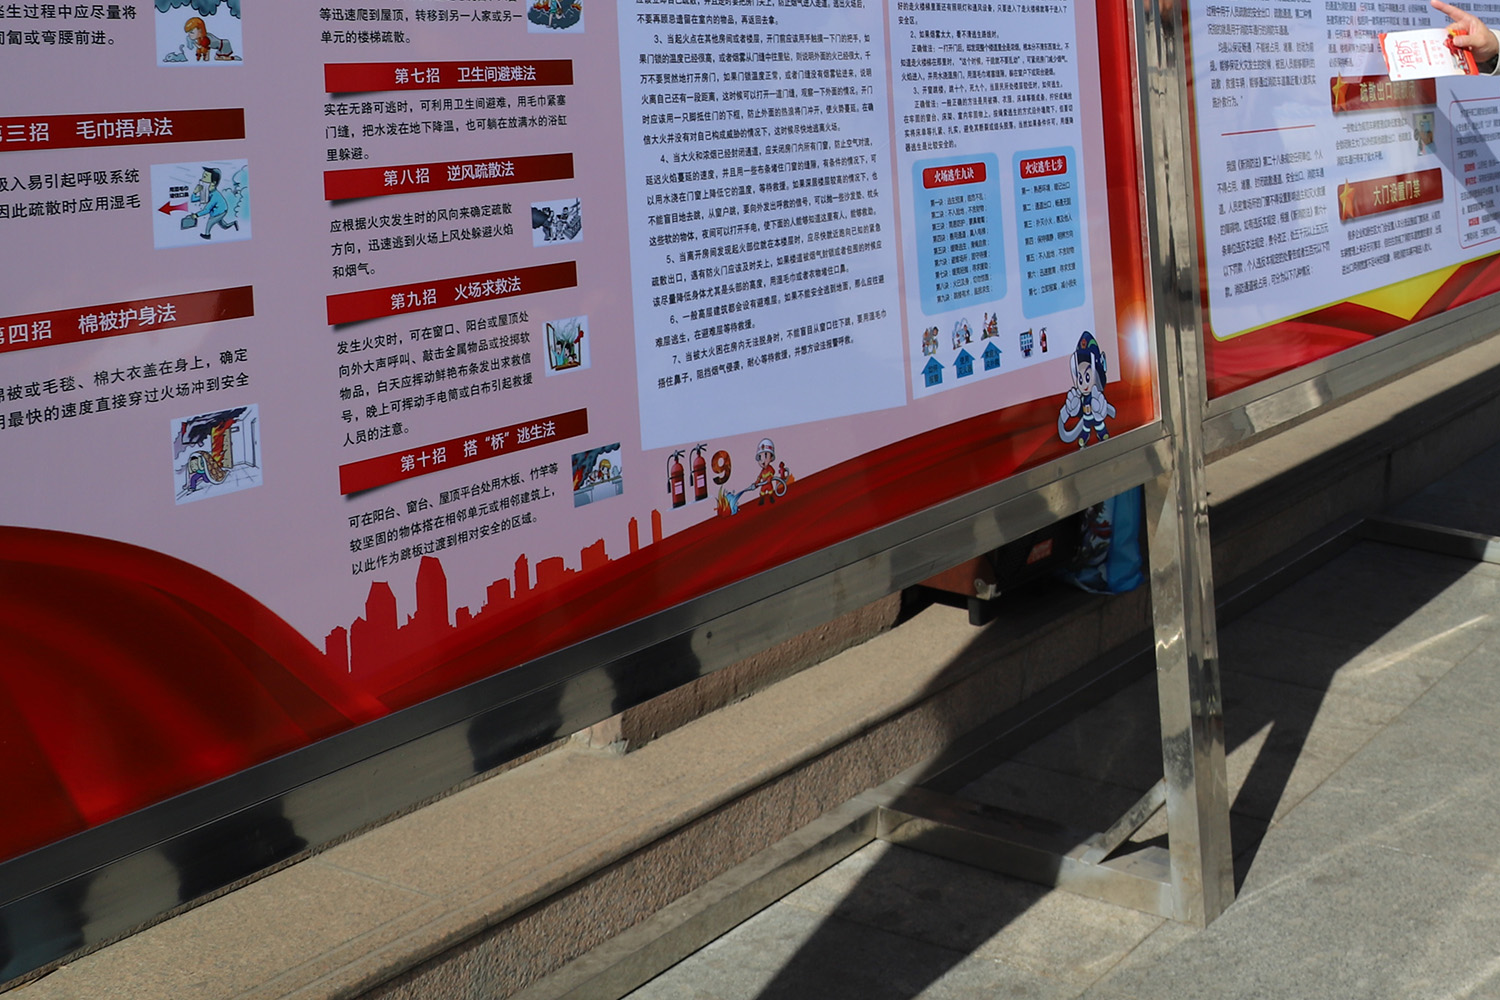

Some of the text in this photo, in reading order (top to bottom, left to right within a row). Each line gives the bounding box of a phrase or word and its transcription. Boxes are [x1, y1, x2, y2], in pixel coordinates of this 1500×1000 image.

[0, 4, 136, 20] 生过程中应尽量将
[320, 30, 411, 45] 单元的楼梯疏散。
[394, 66, 536, 84] 第七招 卫生间避难法
[0, 117, 173, 143] 三招 毛巾捂鼻法
[326, 147, 370, 162] 里躲避。
[383, 161, 515, 187] 第八招 逆风疏散法
[1373, 179, 1421, 206] 大门设置门禁
[330, 202, 513, 233] 应根据火灾发生时的风向来确定疏散
[331, 223, 514, 256] 方向，迅速逃到火场上风处躲避火焰
[332, 262, 376, 279] 和烟气。
[390, 276, 522, 310] 第九招 火场求救法
[0, 303, 177, 344] 四招 棉被护身法
[336, 310, 529, 356] 发生火灾时，可在窗口、阳台或屋顶处
[342, 422, 410, 447] 人员的注意。
[400, 447, 447, 472] 第十招
[351, 513, 538, 576] 以此作为跳板过渡到相对安全的区域。
